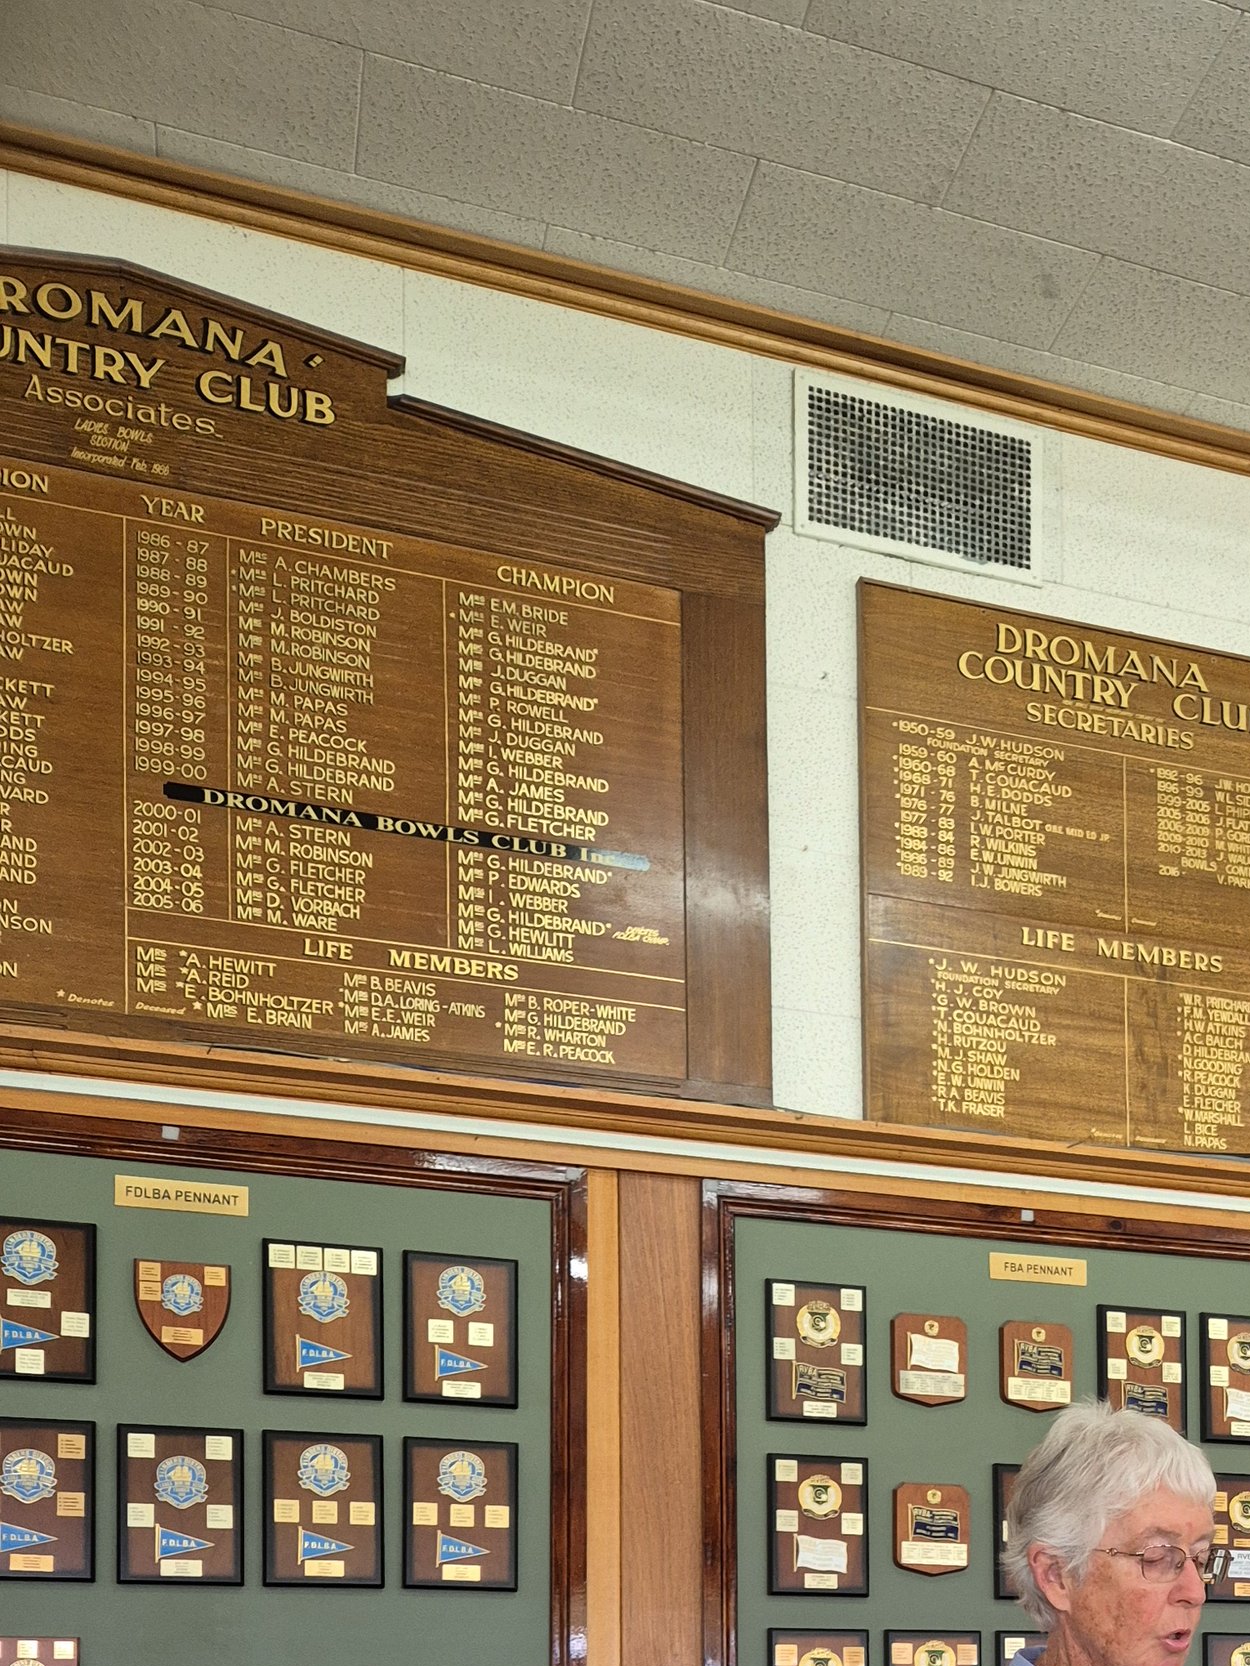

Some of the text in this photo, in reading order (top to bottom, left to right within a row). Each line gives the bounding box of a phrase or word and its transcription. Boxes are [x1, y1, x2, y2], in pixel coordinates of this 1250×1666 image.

[25, 374, 216, 435] Associates
[199, 369, 336, 426] CLUB
[74, 418, 153, 443] LADIES BOWLS
[140, 495, 615, 604] YEAR PRESIDENT CHAMPION
[996, 622, 1208, 694] DROMANA
[957, 651, 1138, 709] COUNTRY
[294, 695, 348, 716] PAPAS
[506, 702, 568, 723] ROWELL
[294, 712, 347, 733] PAPAS
[510, 718, 603, 745] HILDEBRAND
[1026, 702, 1195, 750] SECRETARIES
[289, 728, 367, 753] PEACOCK
[506, 734, 576, 757] DUGGAN
[927, 737, 1049, 767] FOUNDATION SECRETARY
[288, 744, 396, 775] HILDEBRAND
[501, 749, 563, 770] WEBBER
[287, 761, 395, 792] HILDEBRAND
[290, 781, 353, 805] STERN
[509, 782, 565, 802] JAMES
[204, 788, 567, 858] DROMANA BOWLS CLUB
[507, 798, 609, 826] HILDEBRAND
[289, 824, 351, 847] STERN
[507, 817, 596, 841] FLETCHER
[289, 842, 373, 869] ROBINSON
[508, 875, 581, 898] EDWARDS
[1181, 856, 1217, 872] BOWLS
[290, 860, 366, 885] FLETCHER
[509, 892, 568, 913] WEBBER
[290, 878, 366, 903] FLETCHER
[291, 896, 361, 920] VORBACH
[292, 912, 338, 932] WARE
[509, 942, 575, 964] WILLIAMS
[1021, 926, 1223, 973] LIFE MEMBERS
[303, 938, 519, 981] LIFE MEMBERS
[937, 971, 1060, 995] FOUNDATION SECRETARY
[990, 965, 1066, 987] HUDSON
[972, 986, 1004, 1000] COY
[125, 1185, 239, 1207] FDLBA PENNANT
[1004, 1261, 1073, 1277] FBA PENNANT
